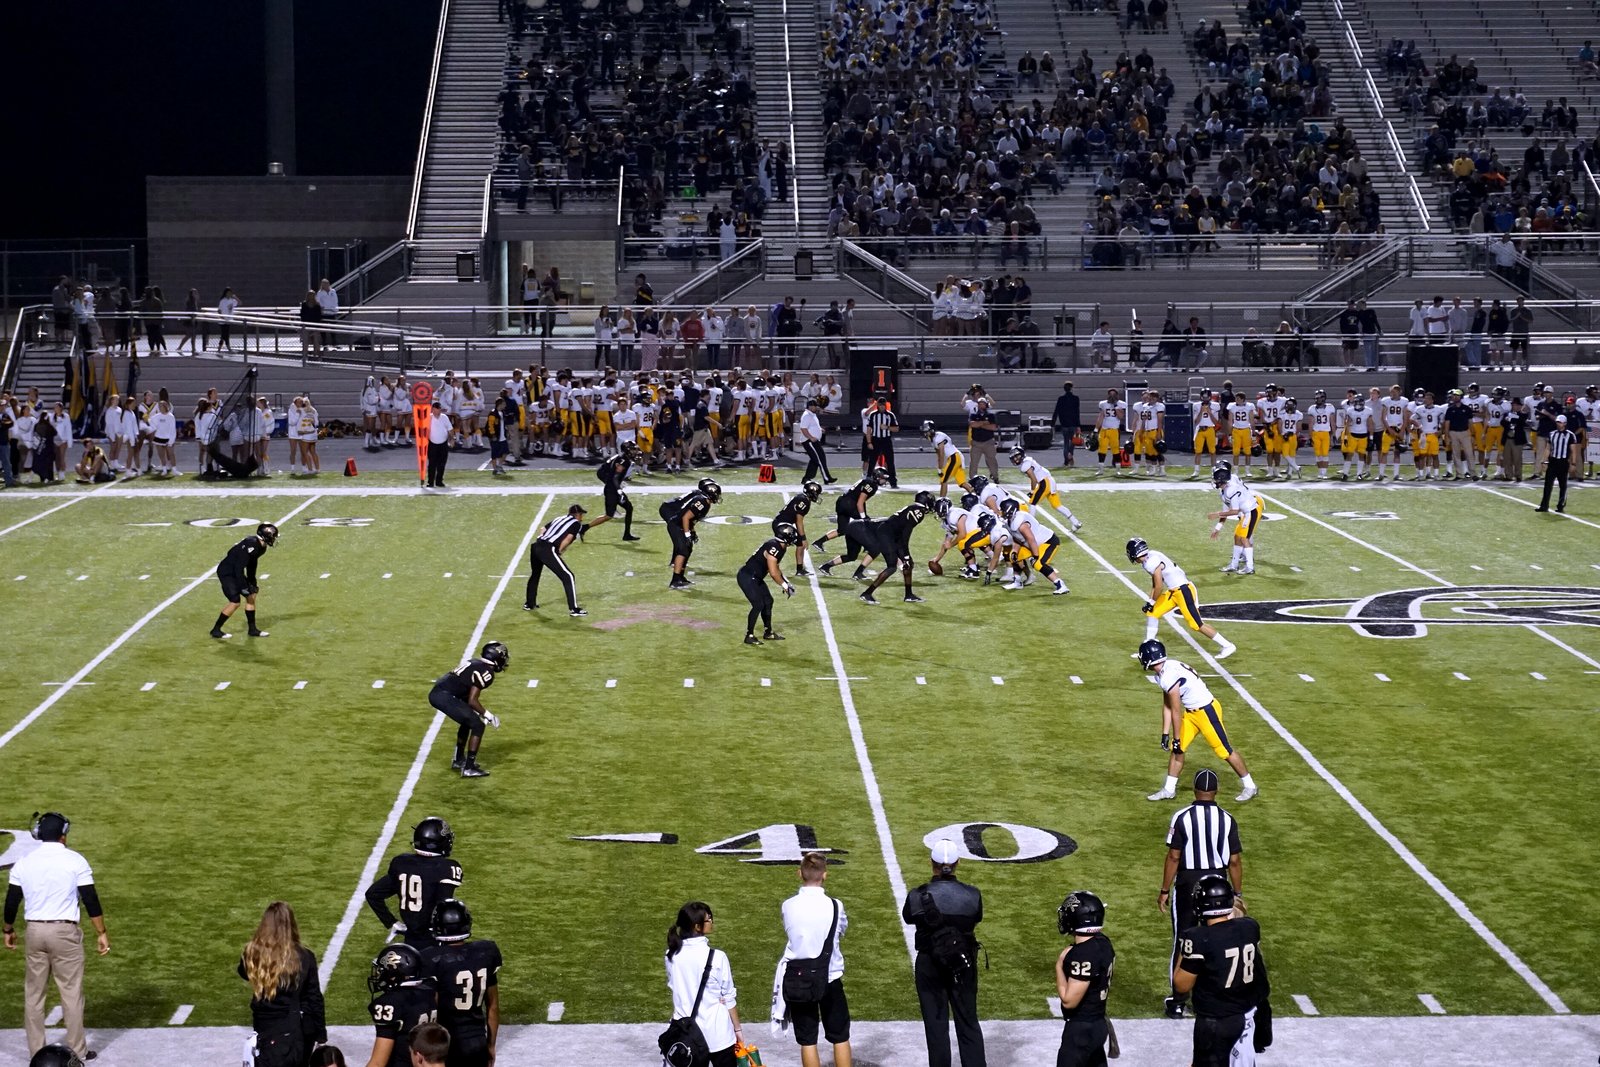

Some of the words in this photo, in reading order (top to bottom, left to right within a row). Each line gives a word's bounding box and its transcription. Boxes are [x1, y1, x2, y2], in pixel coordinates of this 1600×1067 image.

[878, 370, 885, 387] 1
[1105, 409, 1117, 418] 53
[1235, 411, 1247, 421] 62
[1266, 408, 1278, 418] 78
[1316, 414, 1328, 424] 83
[1284, 420, 1296, 429] 87
[759, 467, 772, 480] 40
[914, 509, 923, 519] 42
[769, 547, 780, 557] 21
[482, 671, 492, 682] 10
[451, 866, 463, 880] 19
[398, 873, 423, 912] 19
[1179, 938, 1193, 954] 78
[1071, 961, 1092, 976] 32
[1225, 943, 1256, 989] 78
[454, 967, 488, 1010] 31
[374, 1004, 394, 1021] 33
